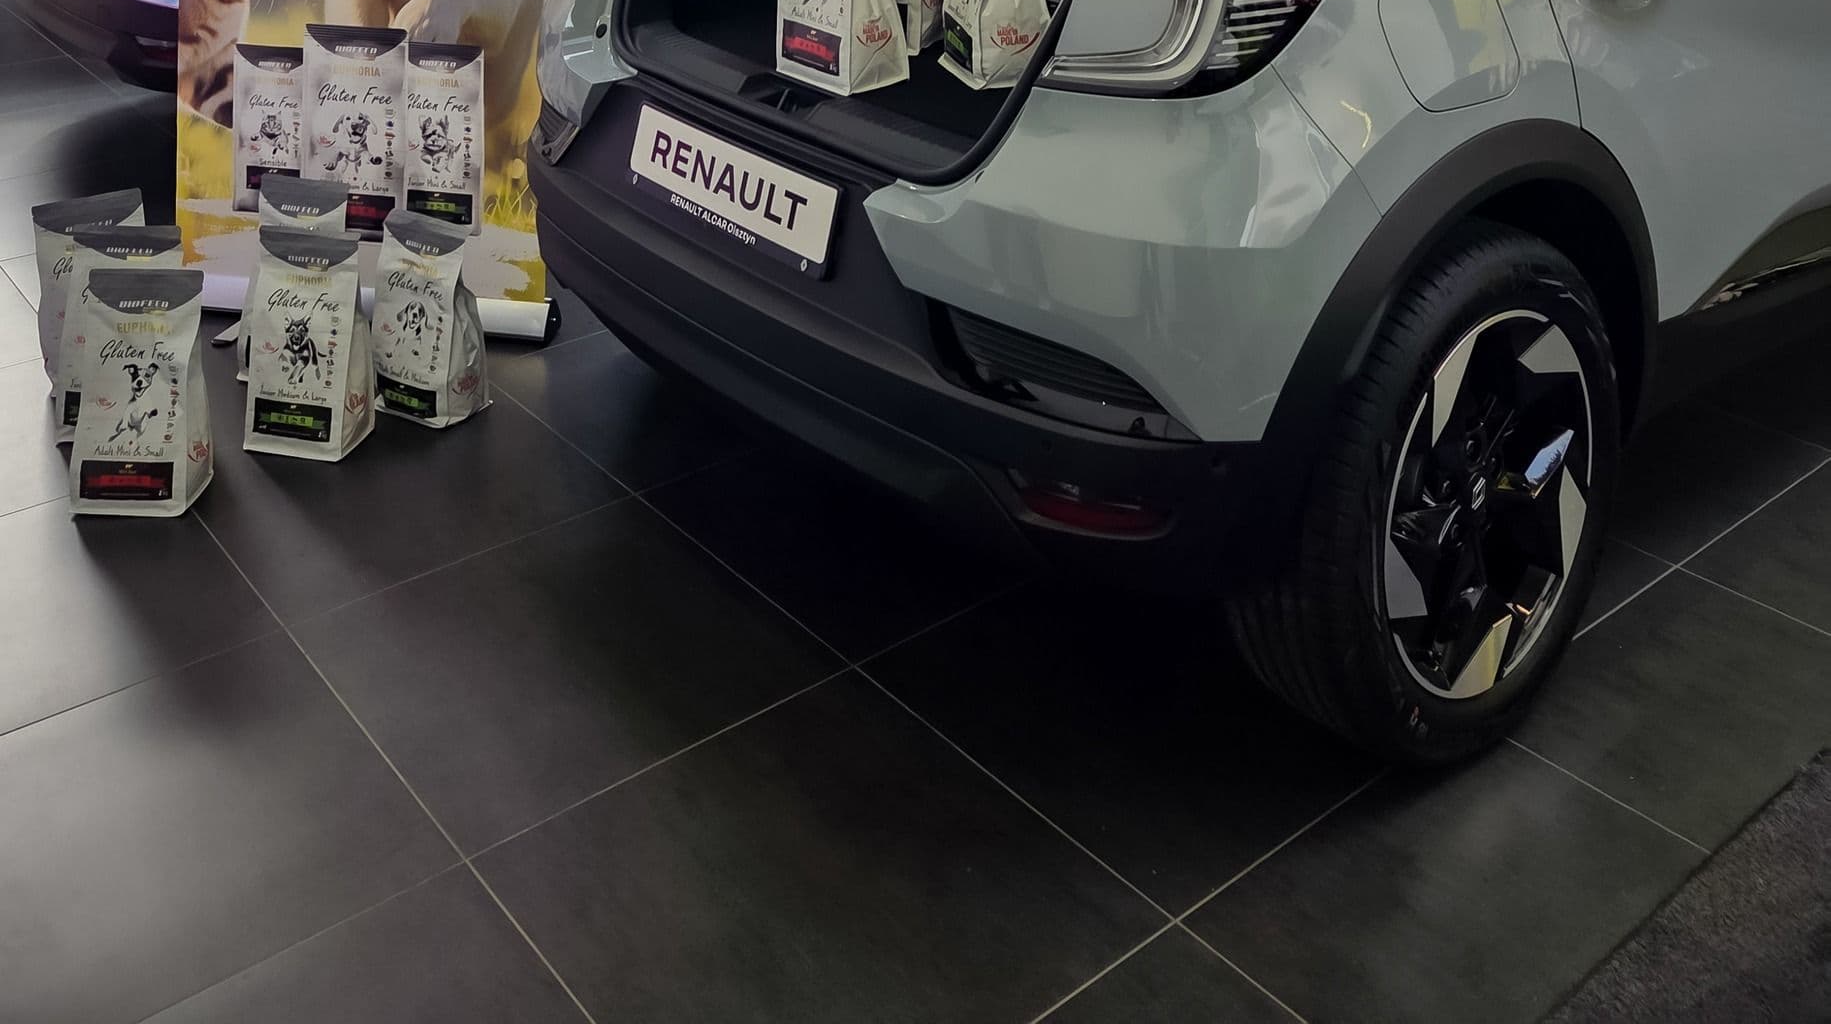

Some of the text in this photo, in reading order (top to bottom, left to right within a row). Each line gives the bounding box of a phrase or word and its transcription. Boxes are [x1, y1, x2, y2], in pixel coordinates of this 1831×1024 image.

[1000, 34, 1029, 46] POLAND
[279, 96, 299, 109] Free
[317, 83, 393, 107] Gluten Free
[443, 95, 471, 113] Free
[650, 130, 808, 231] RENAULT
[670, 194, 756, 246] RENAULT ALCAR Olsztyn
[388, 271, 419, 294] Gluten
[267, 288, 341, 313] Gluten Free
[99, 339, 175, 365] Gluten Free
